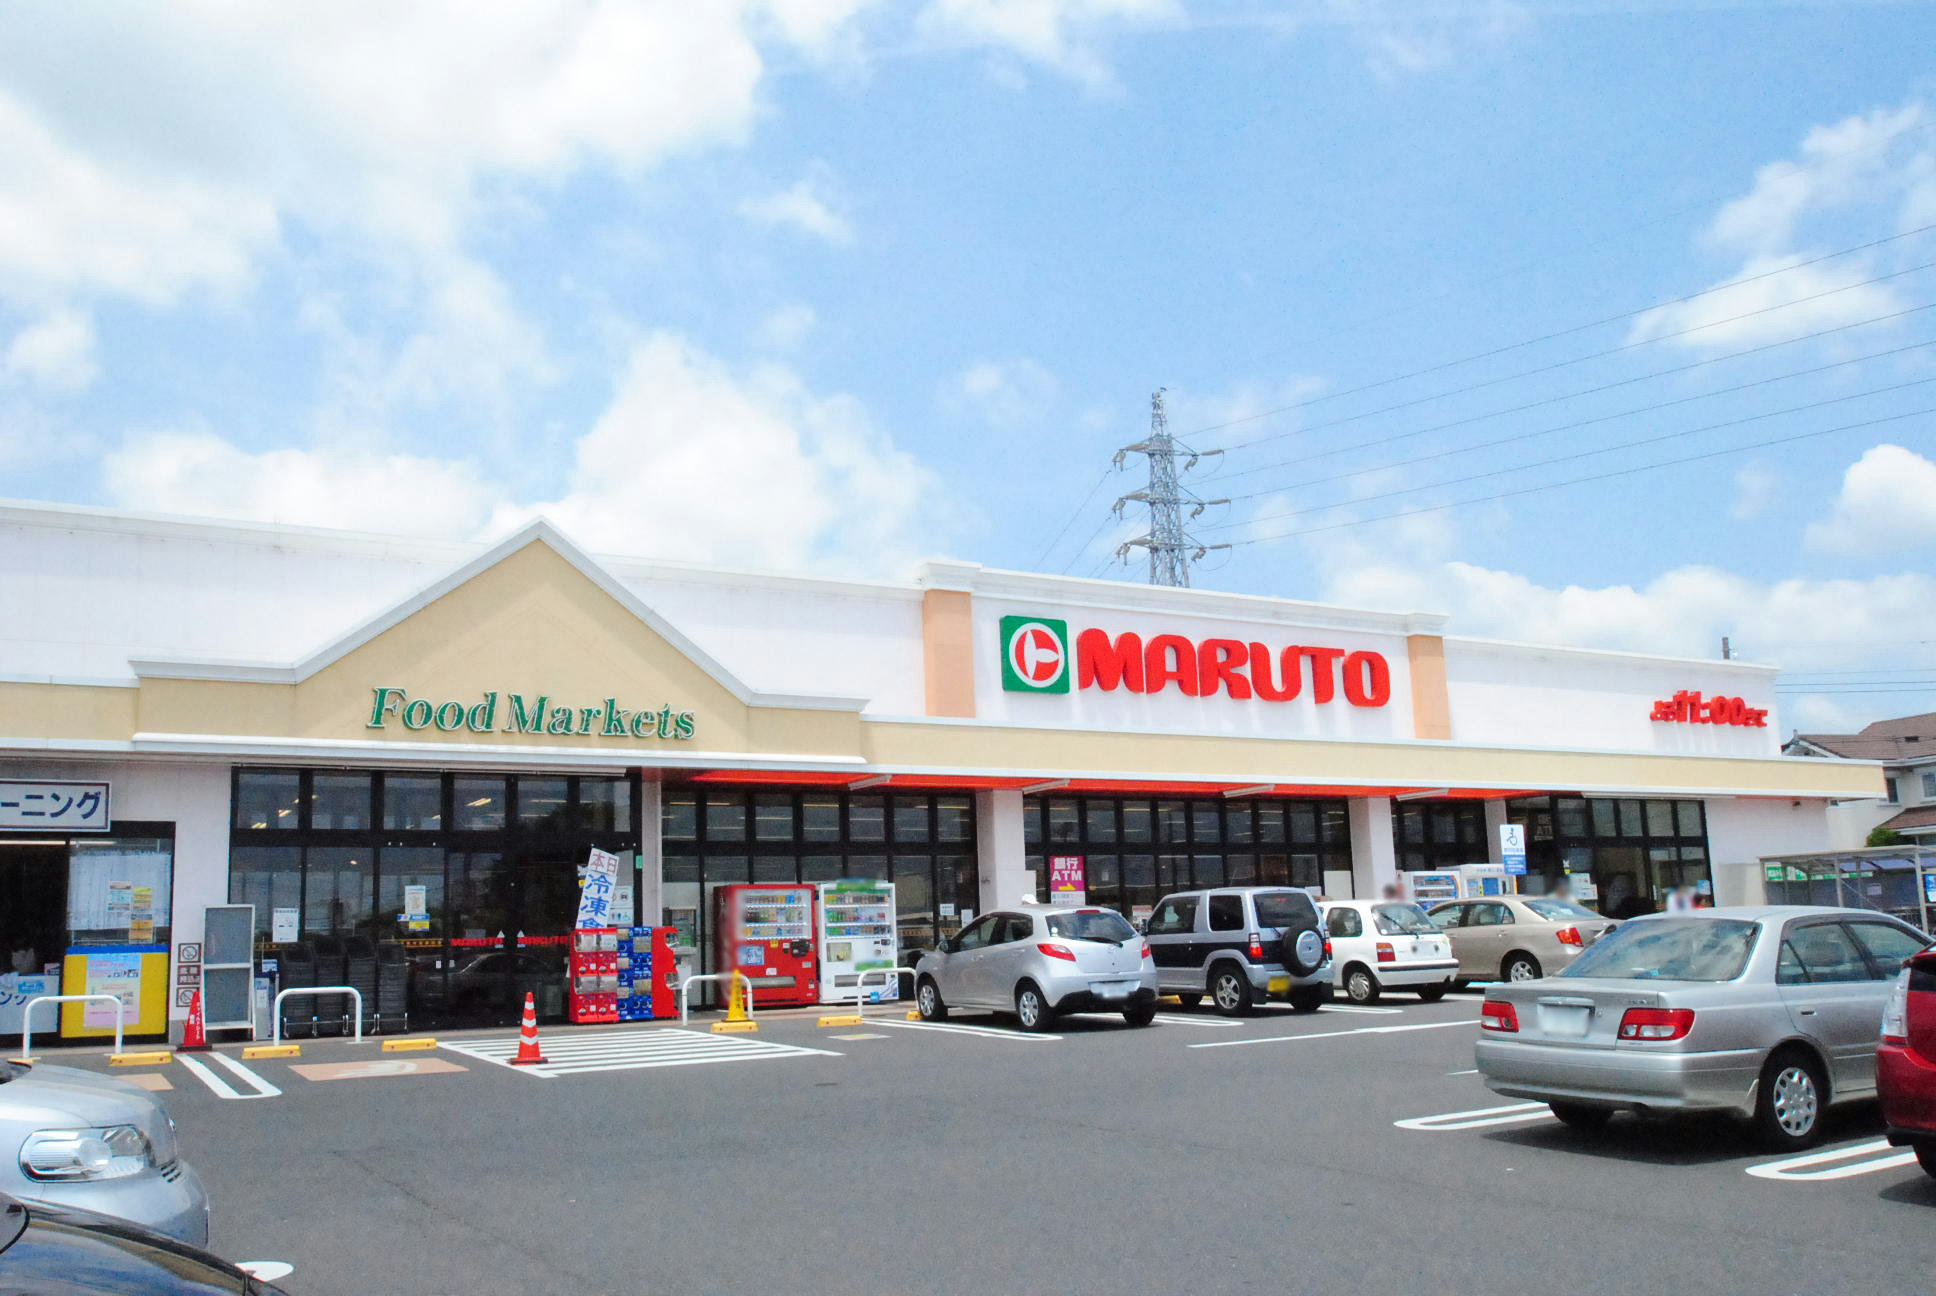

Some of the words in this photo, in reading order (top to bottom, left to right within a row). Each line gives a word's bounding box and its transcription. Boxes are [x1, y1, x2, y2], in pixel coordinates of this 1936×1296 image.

[1077, 628, 1391, 707] MARUTO
[366, 687, 499, 732] Food
[502, 694, 696, 740] Markets
[591, 852, 618, 874] 本日
[1055, 857, 1078, 869] 銀行
[1052, 870, 1082, 880] ATM
